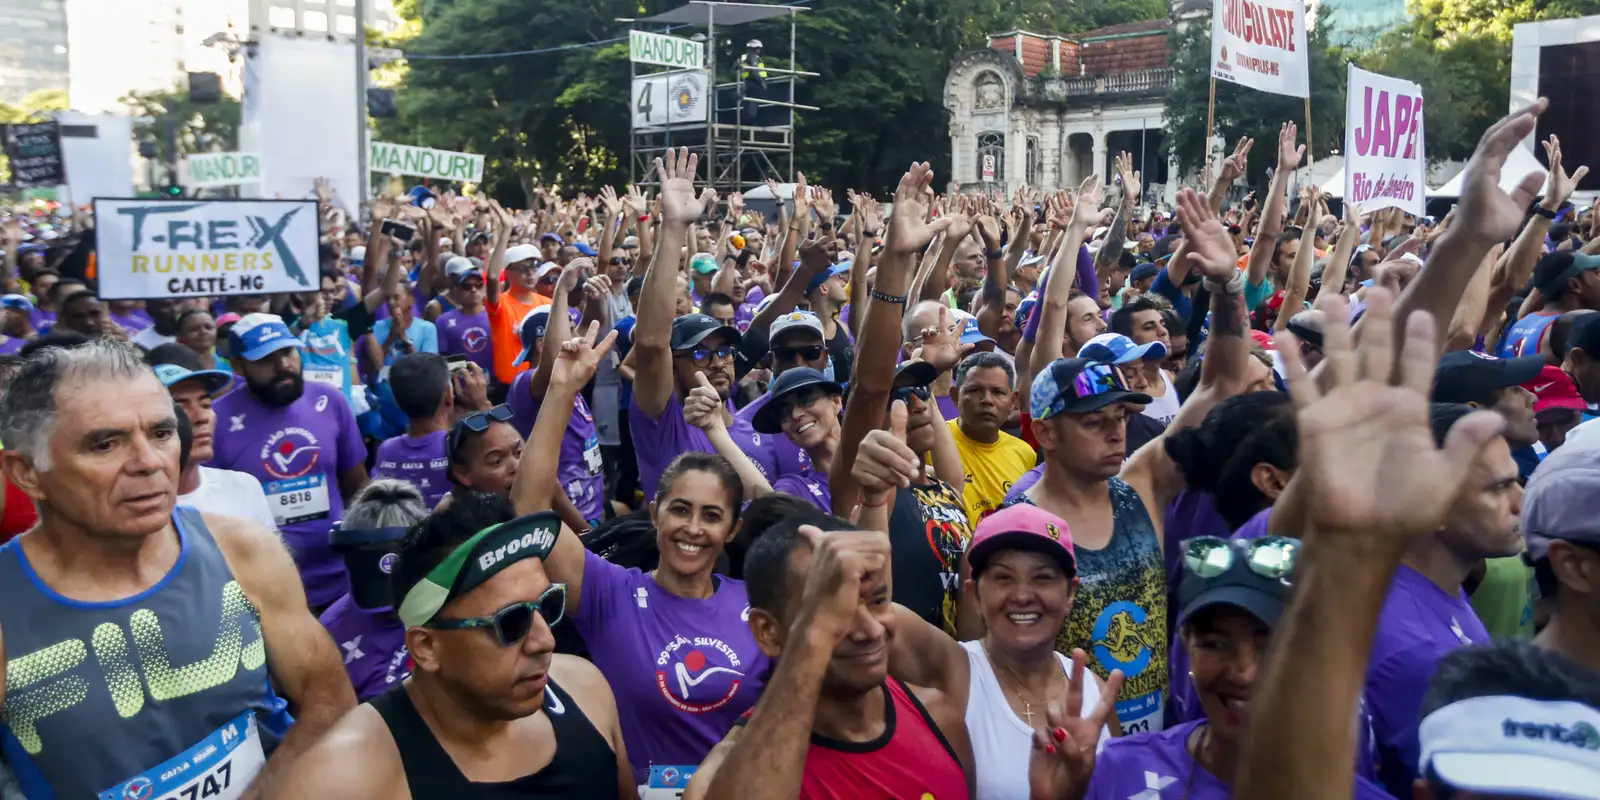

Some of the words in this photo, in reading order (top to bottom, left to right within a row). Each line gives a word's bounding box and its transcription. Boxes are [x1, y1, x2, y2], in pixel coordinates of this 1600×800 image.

[632, 34, 697, 66] MANDURI
[637, 82, 653, 122] 4
[189, 155, 260, 181] MANDURI
[371, 145, 475, 178] MANDURI
[1353, 172, 1372, 202] Rio
[117, 202, 311, 286] T-REX
[132, 252, 273, 273] RUNNERS
[280, 491, 312, 506] 8818
[694, 637, 741, 667] SILVESTRE
[221, 723, 239, 745] M
[165, 759, 233, 800] 747
